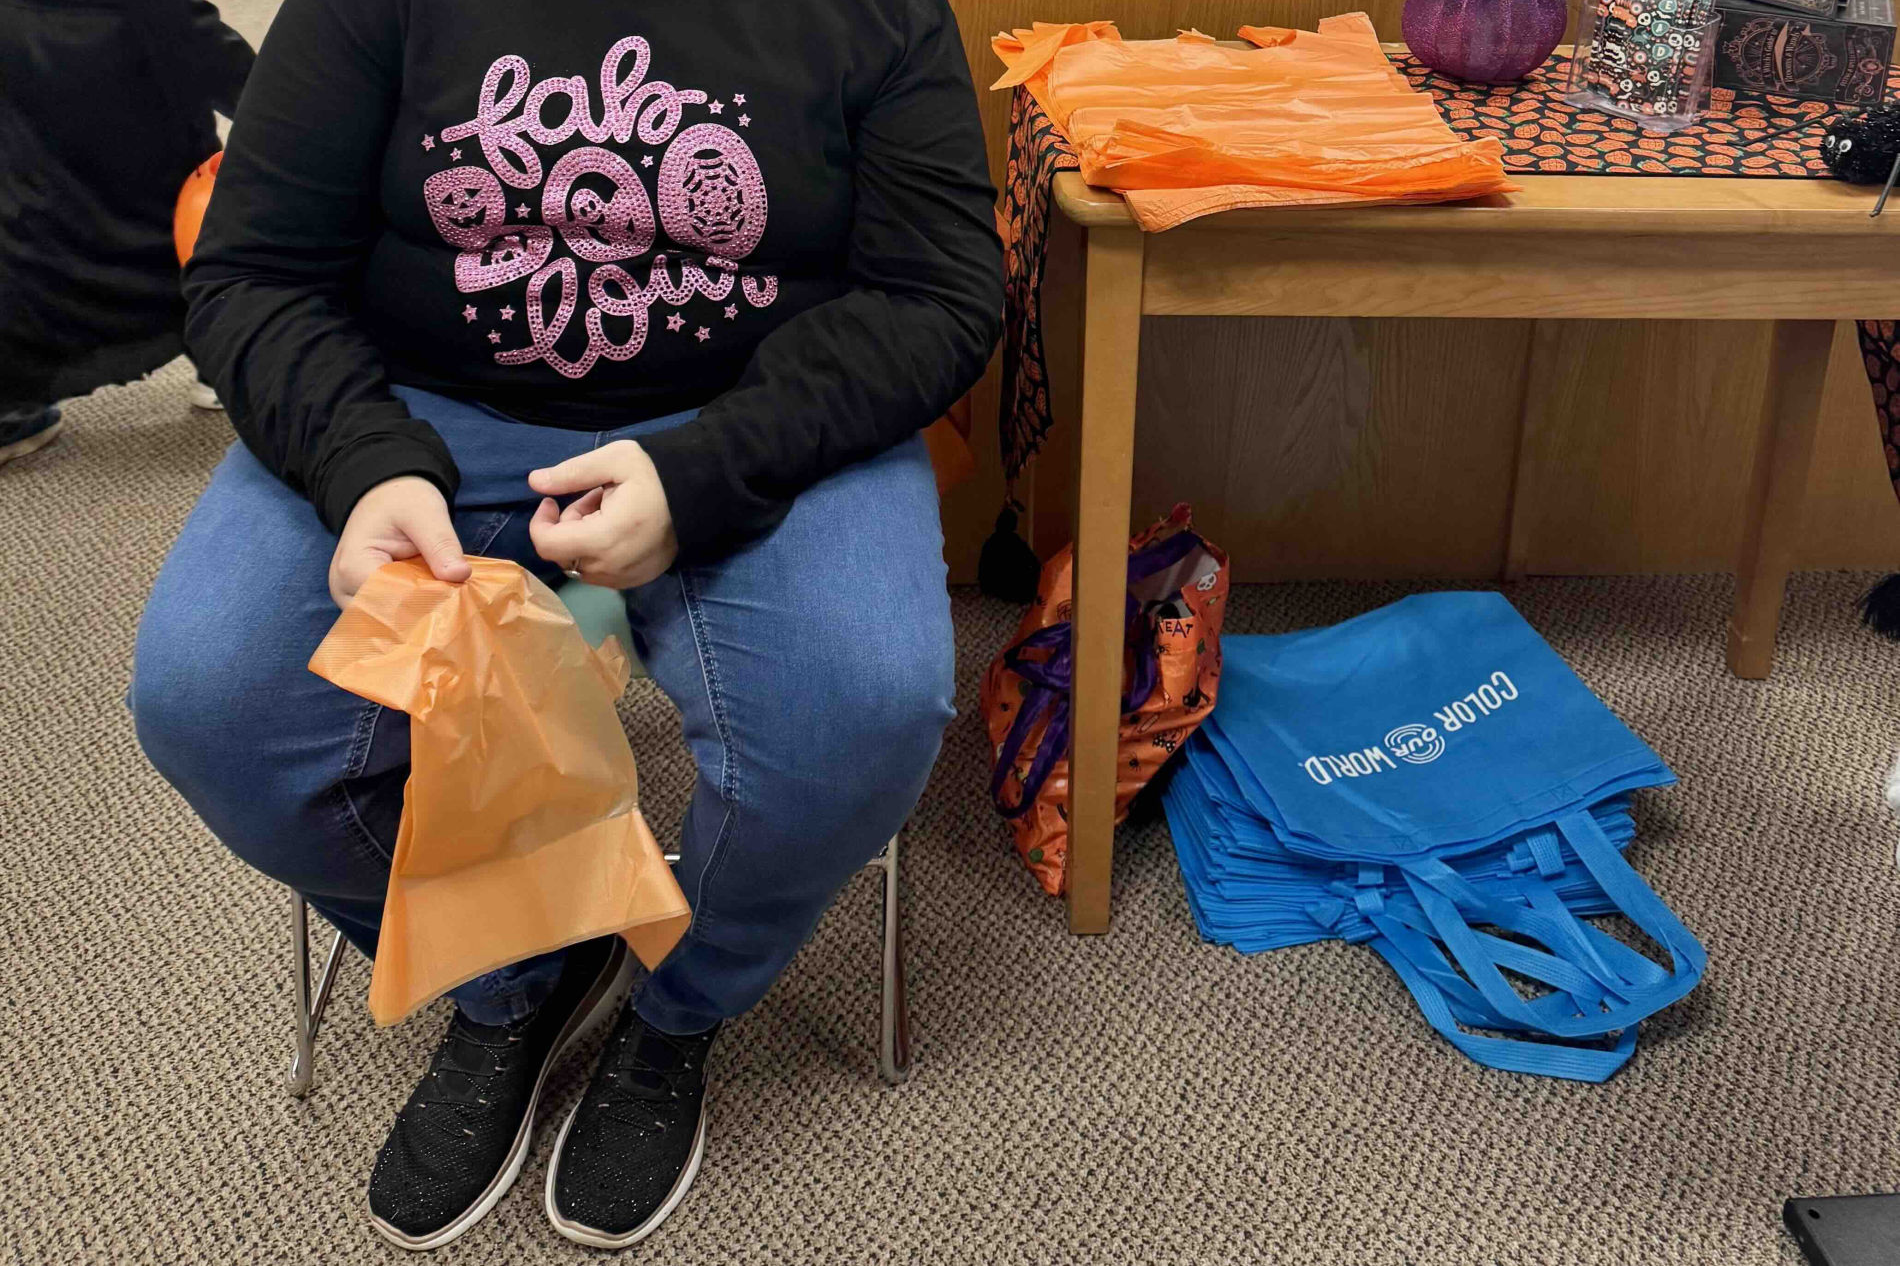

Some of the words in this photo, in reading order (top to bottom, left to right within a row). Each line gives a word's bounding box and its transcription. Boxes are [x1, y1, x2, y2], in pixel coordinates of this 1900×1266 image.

[441, 36, 708, 189] fab
[1433, 671, 1519, 732] COLOR
[1389, 727, 1438, 757] OUR
